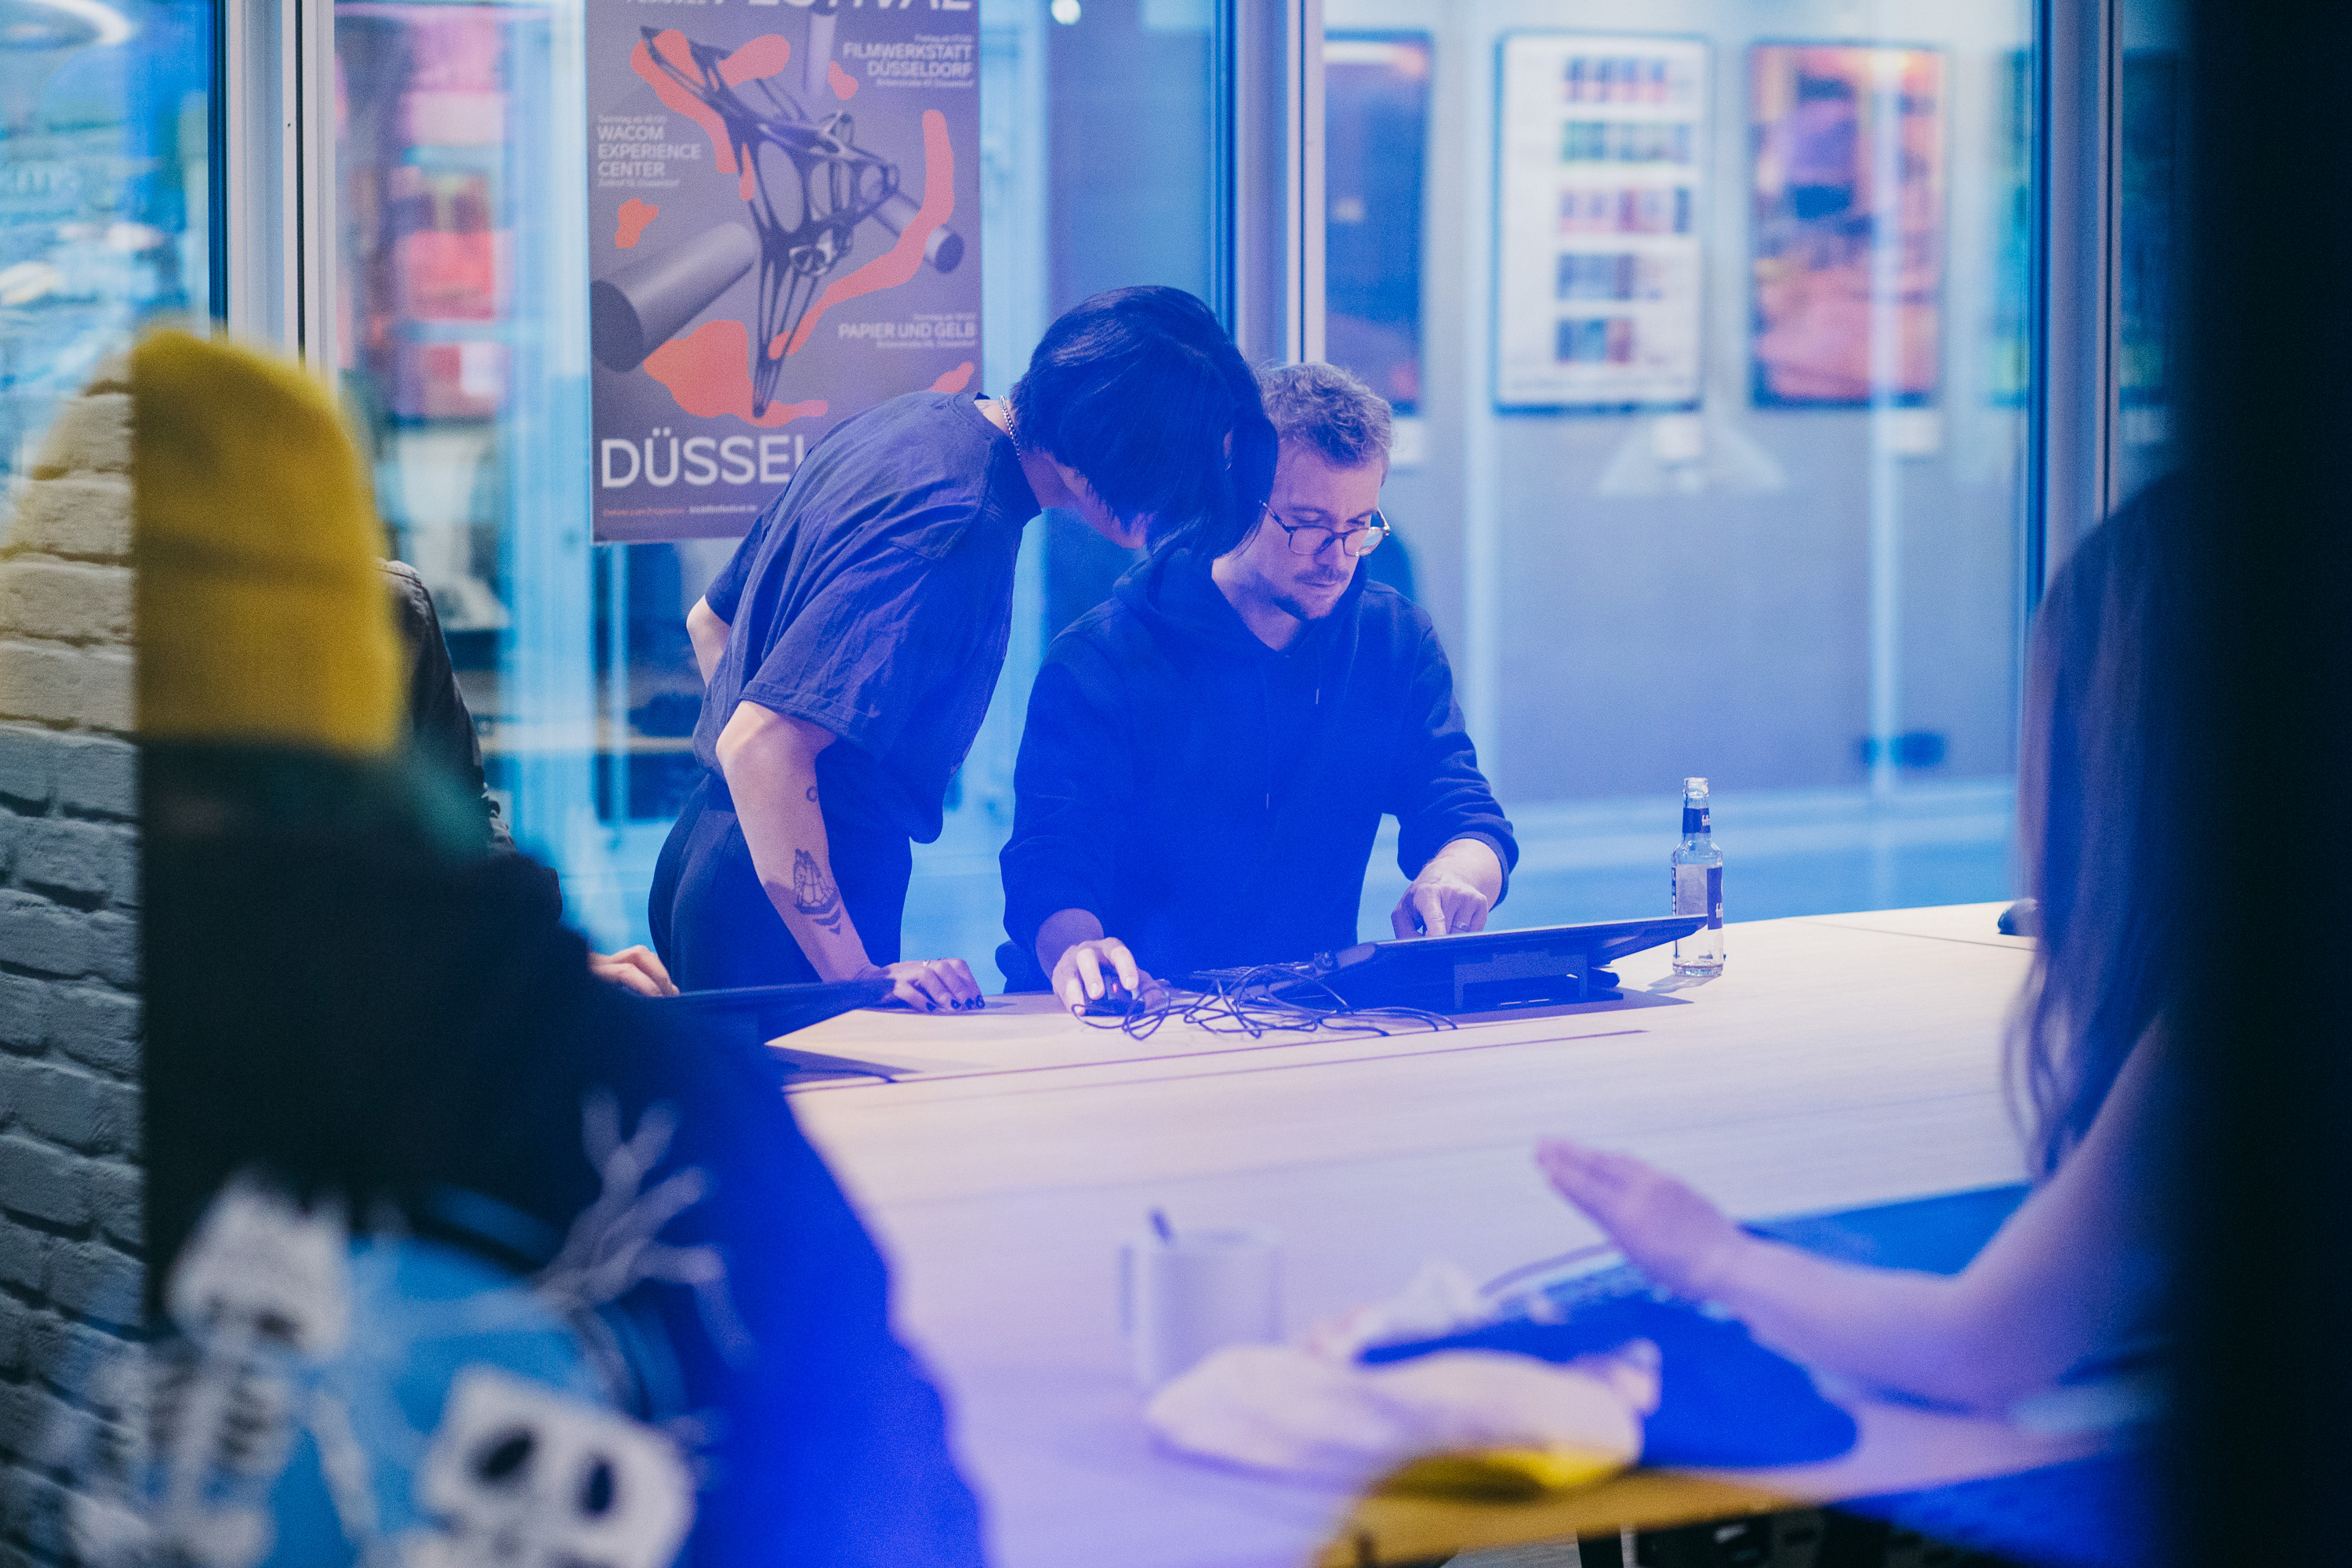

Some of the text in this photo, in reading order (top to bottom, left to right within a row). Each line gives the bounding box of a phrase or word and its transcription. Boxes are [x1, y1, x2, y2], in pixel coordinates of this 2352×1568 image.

[843, 42, 972, 60] FILMWERKSTATT
[867, 59, 972, 78] DÜSSELDORF
[597, 125, 664, 140] WACOM
[597, 143, 700, 160] EXPERIENCE
[597, 162, 666, 178] CENTER
[839, 322, 975, 339] PAPIER UND GELB
